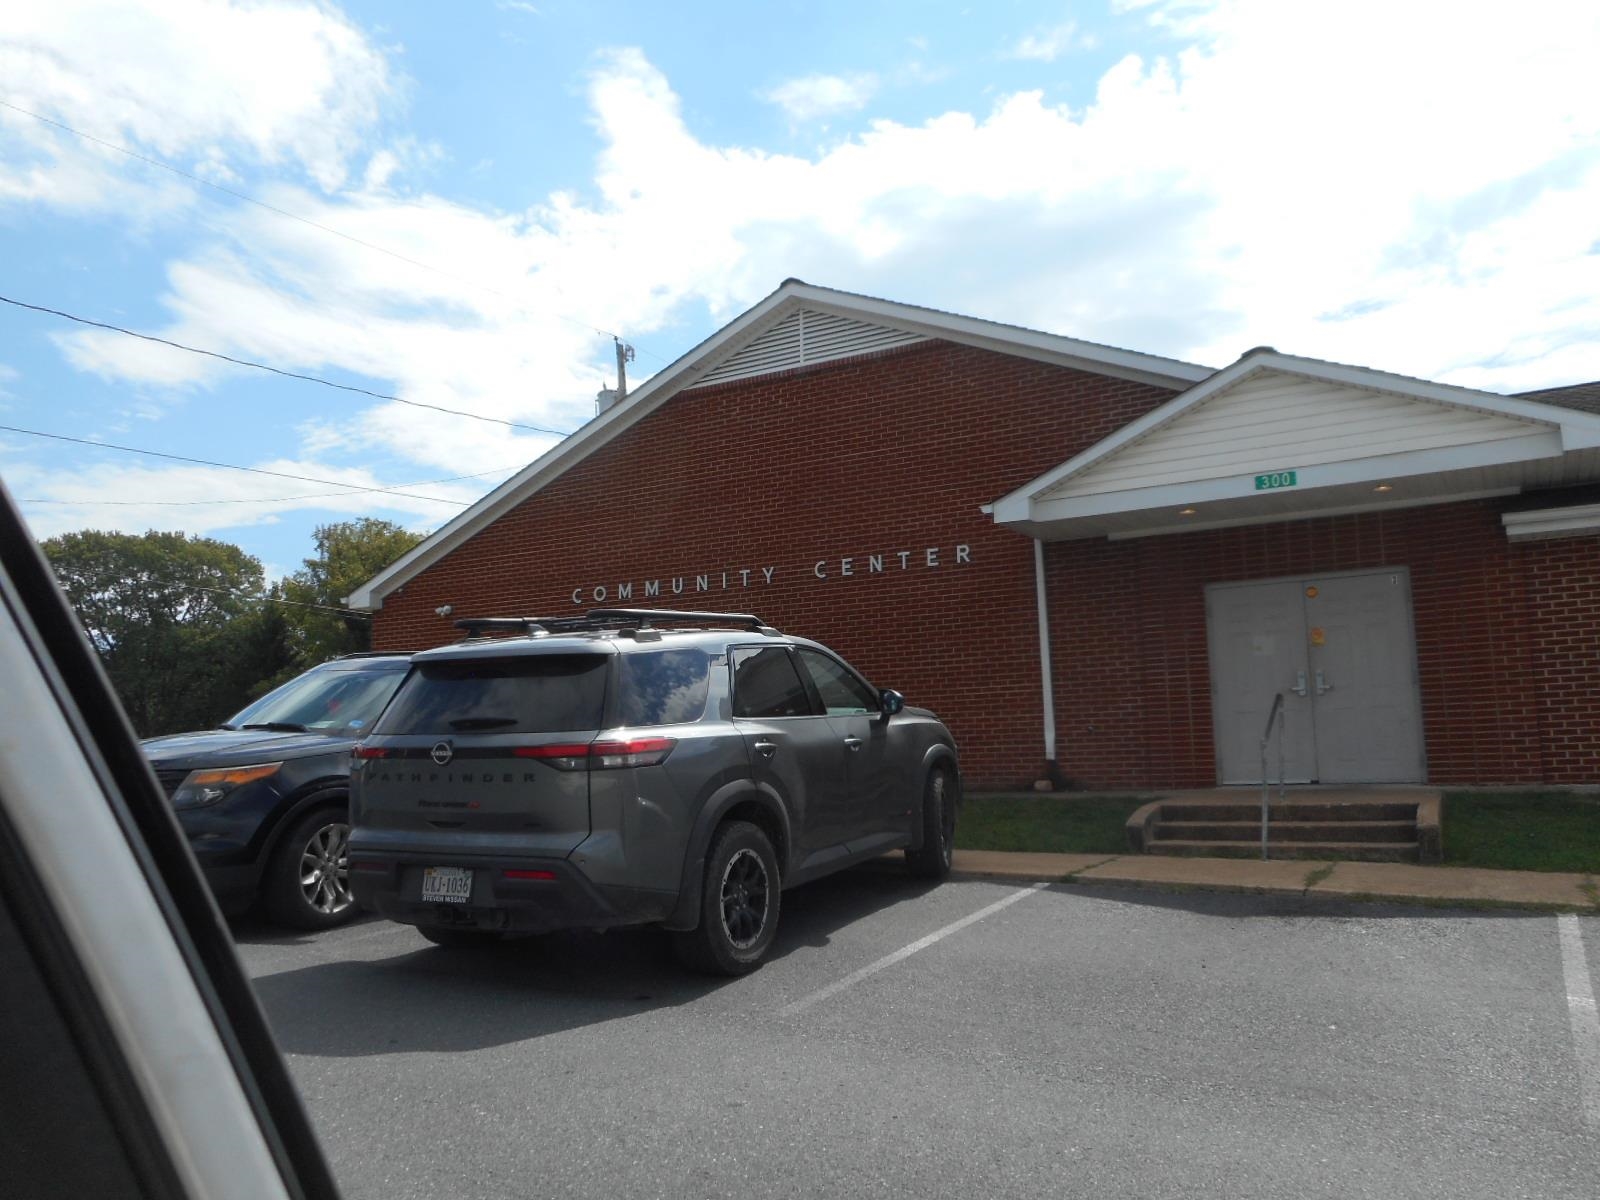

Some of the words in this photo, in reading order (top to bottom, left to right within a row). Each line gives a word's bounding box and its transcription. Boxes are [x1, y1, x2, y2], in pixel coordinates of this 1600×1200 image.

[1262, 472, 1290, 489] 300
[572, 567, 774, 604] COMMUNITY
[814, 544, 970, 579] CENTER
[367, 772, 537, 783] PATHFINDER
